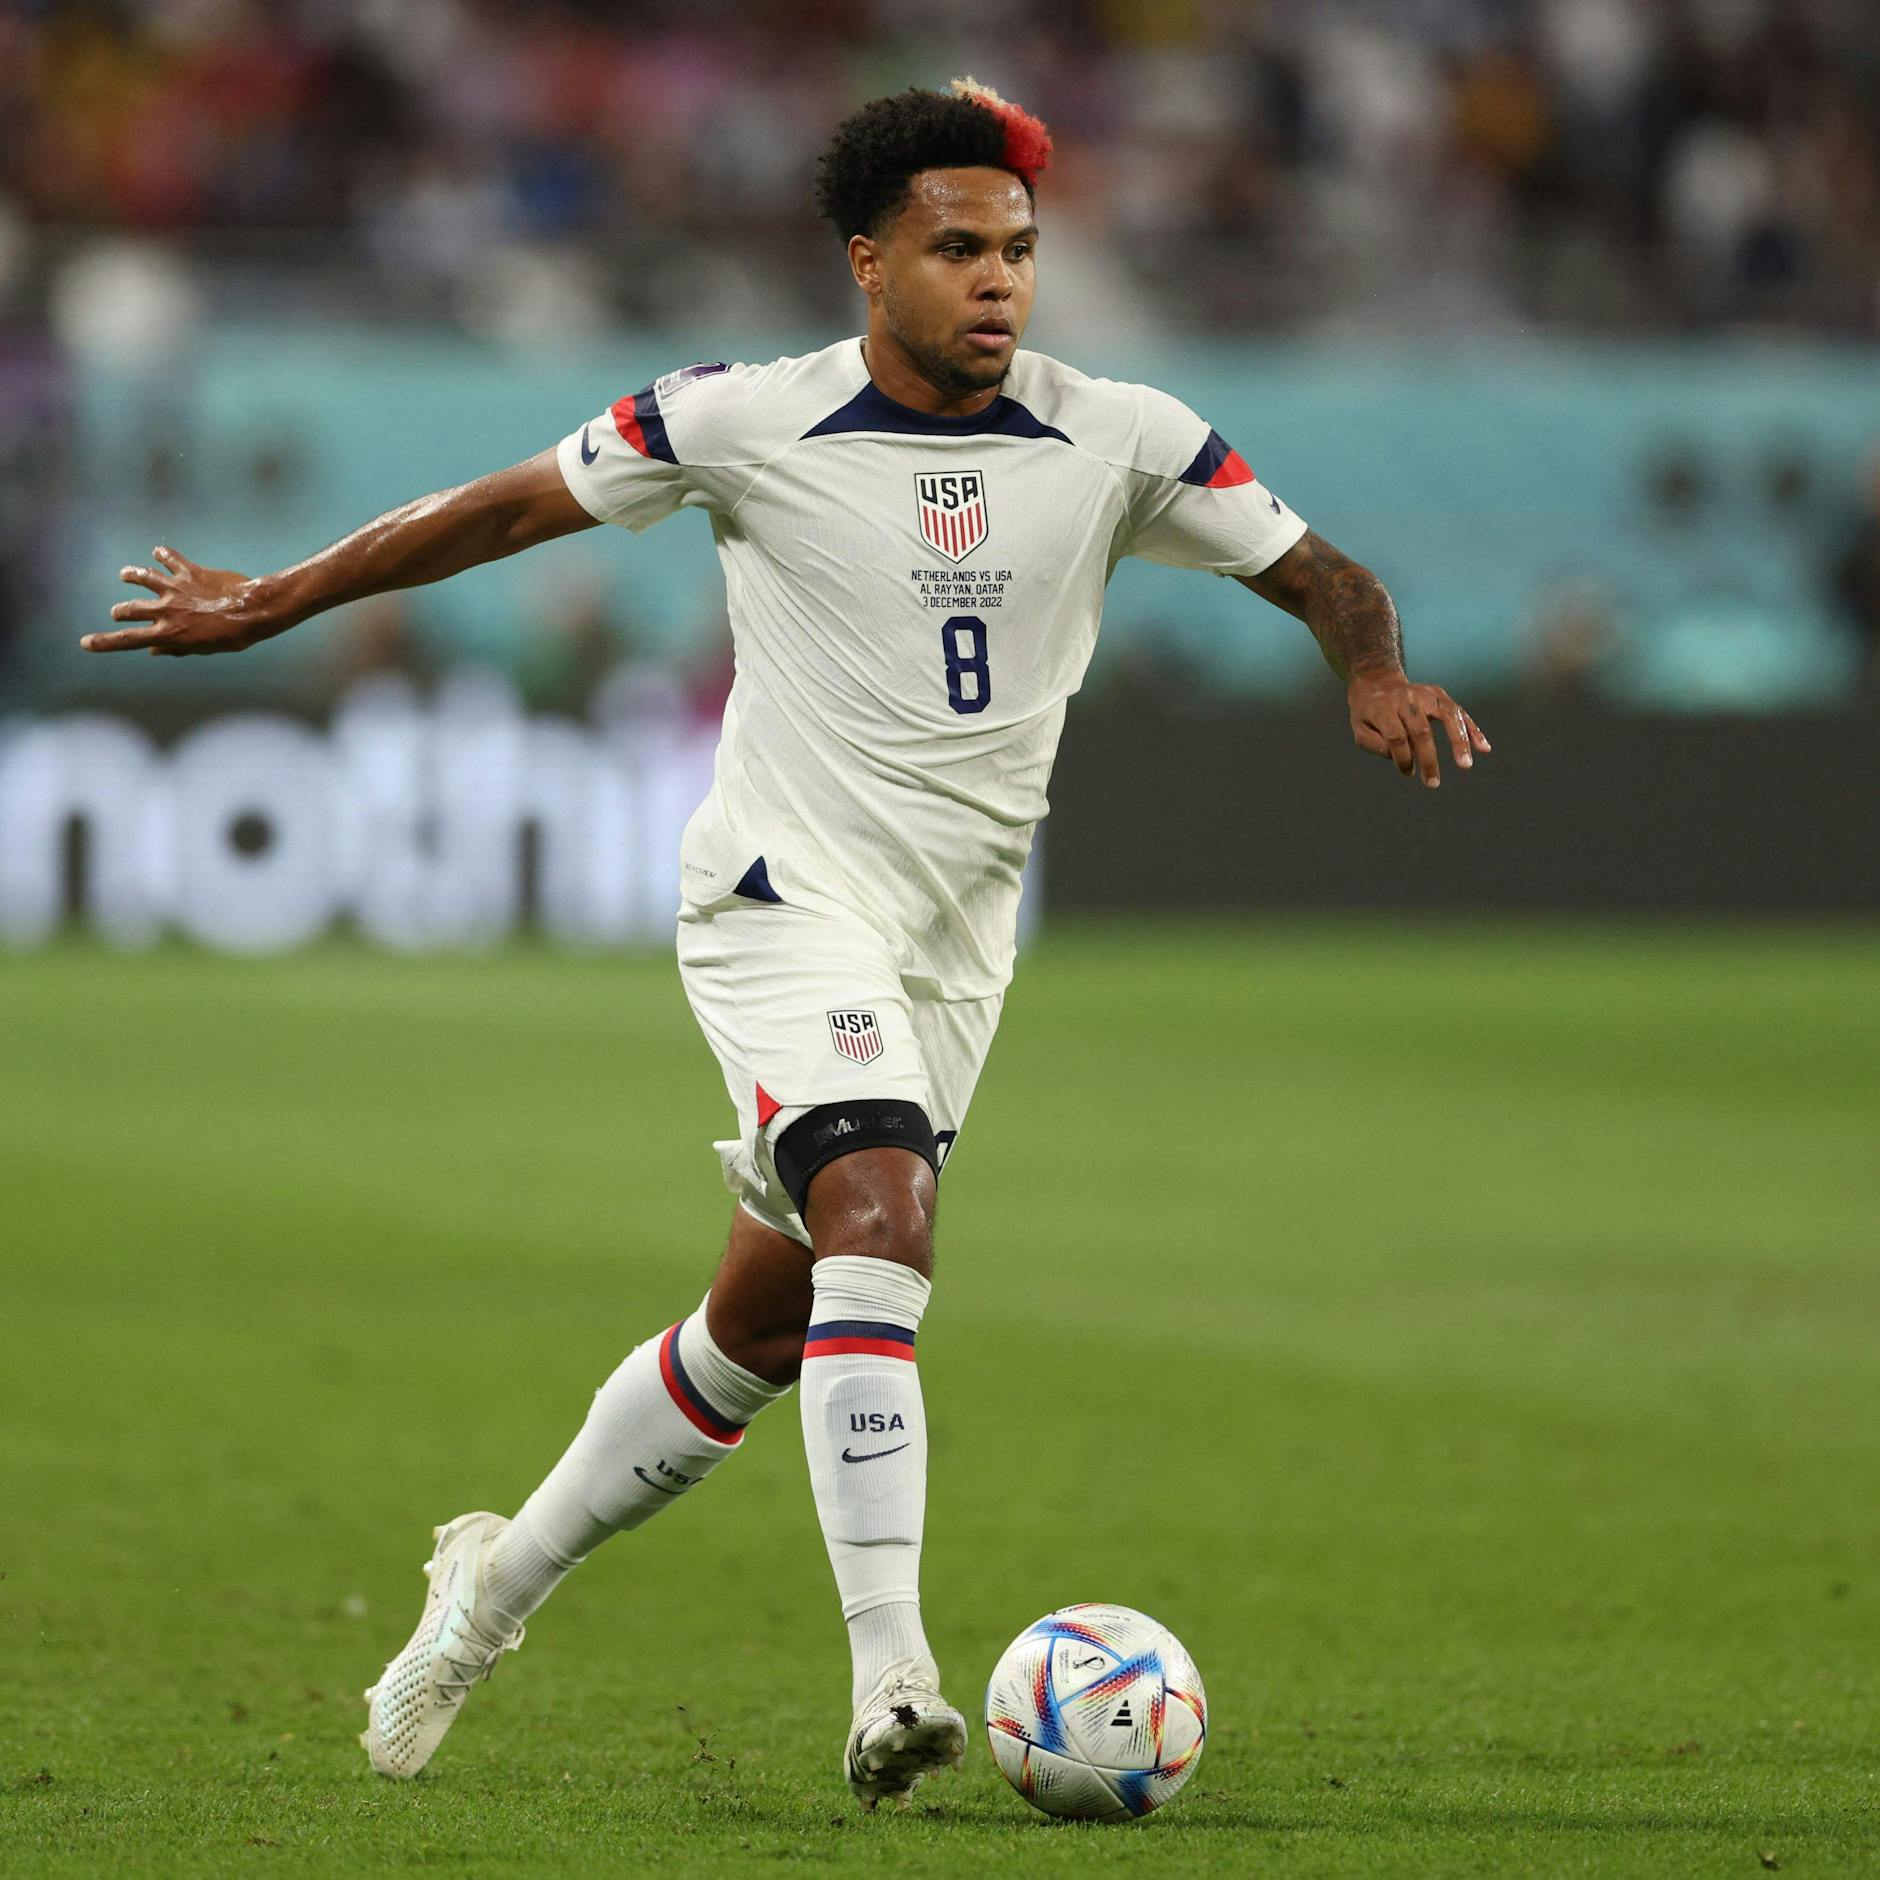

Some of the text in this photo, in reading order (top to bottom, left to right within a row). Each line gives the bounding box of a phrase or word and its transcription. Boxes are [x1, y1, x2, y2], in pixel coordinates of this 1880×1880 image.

[920, 476, 979, 510] USA
[911, 570, 1013, 582] NETHERLANDS VS USA
[920, 582, 1004, 596] AL RAYYAN, QATAR
[923, 596, 1002, 608] 3 DECEMBER 2022
[942, 616, 991, 715] 8
[832, 1014, 874, 1034] USA
[850, 1413, 905, 1433] USA
